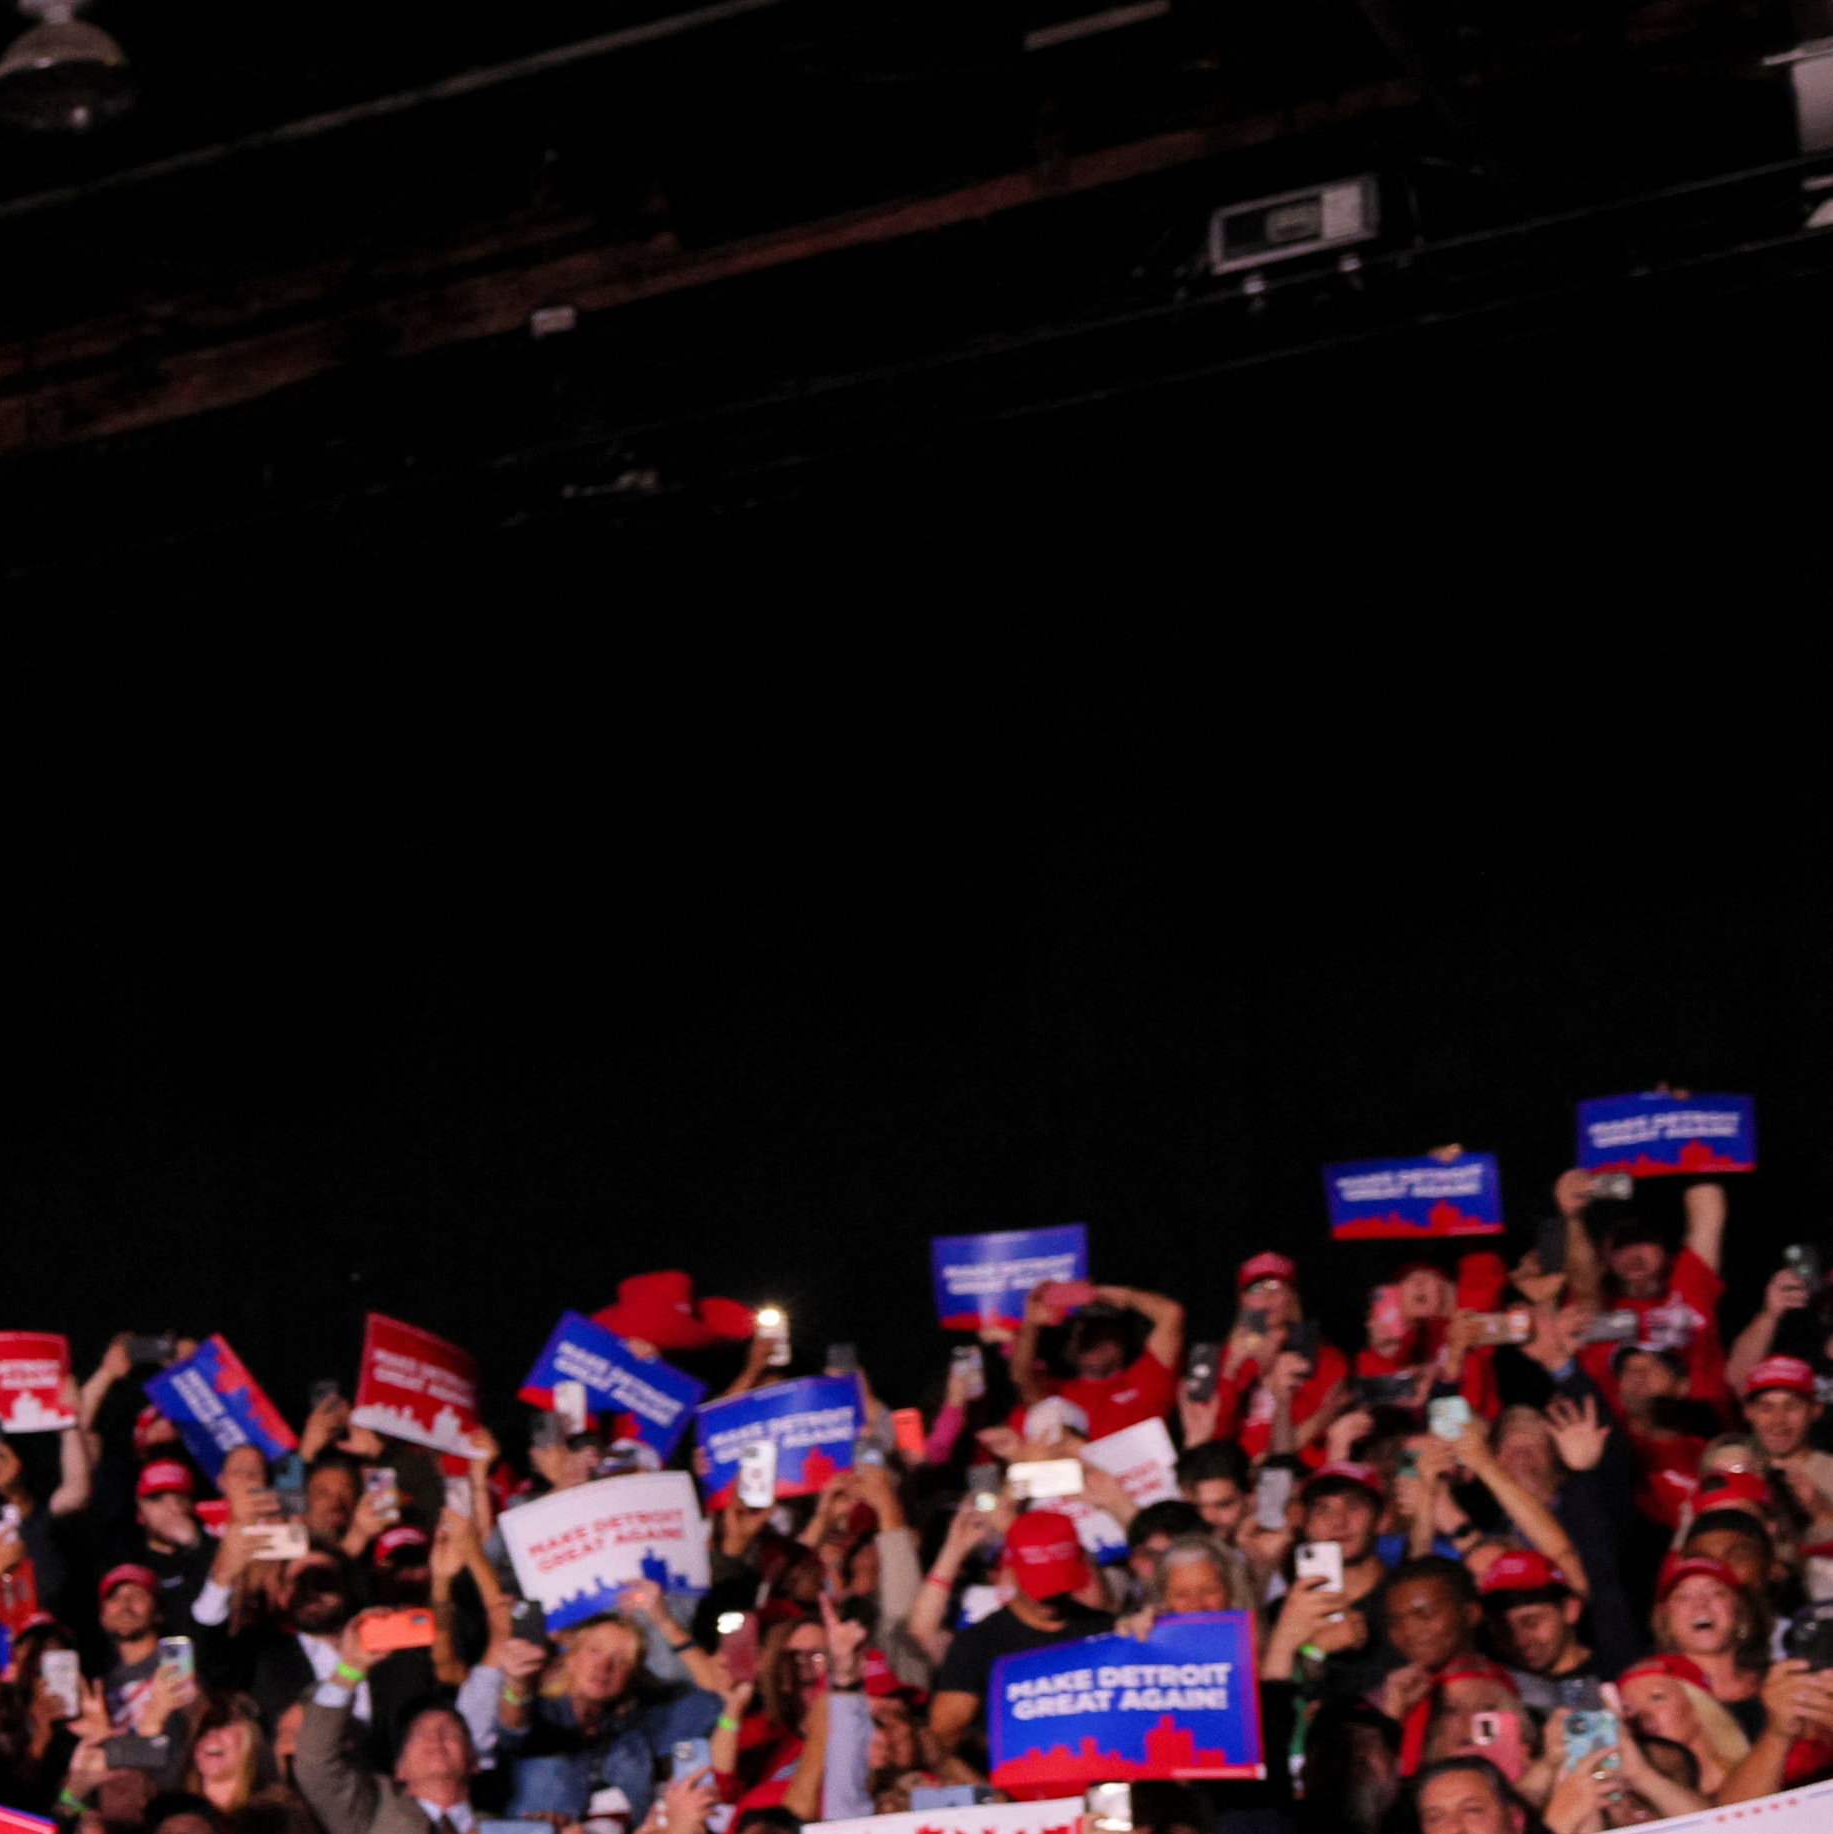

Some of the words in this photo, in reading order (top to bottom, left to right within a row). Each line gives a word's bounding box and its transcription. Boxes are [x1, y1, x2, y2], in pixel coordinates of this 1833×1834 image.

[1005, 1668, 1094, 1702] MAKE
[1097, 1662, 1233, 1688] DETROIT
[1011, 1689, 1114, 1721] GREAT
[1118, 1687, 1229, 1711] AGAIN!
